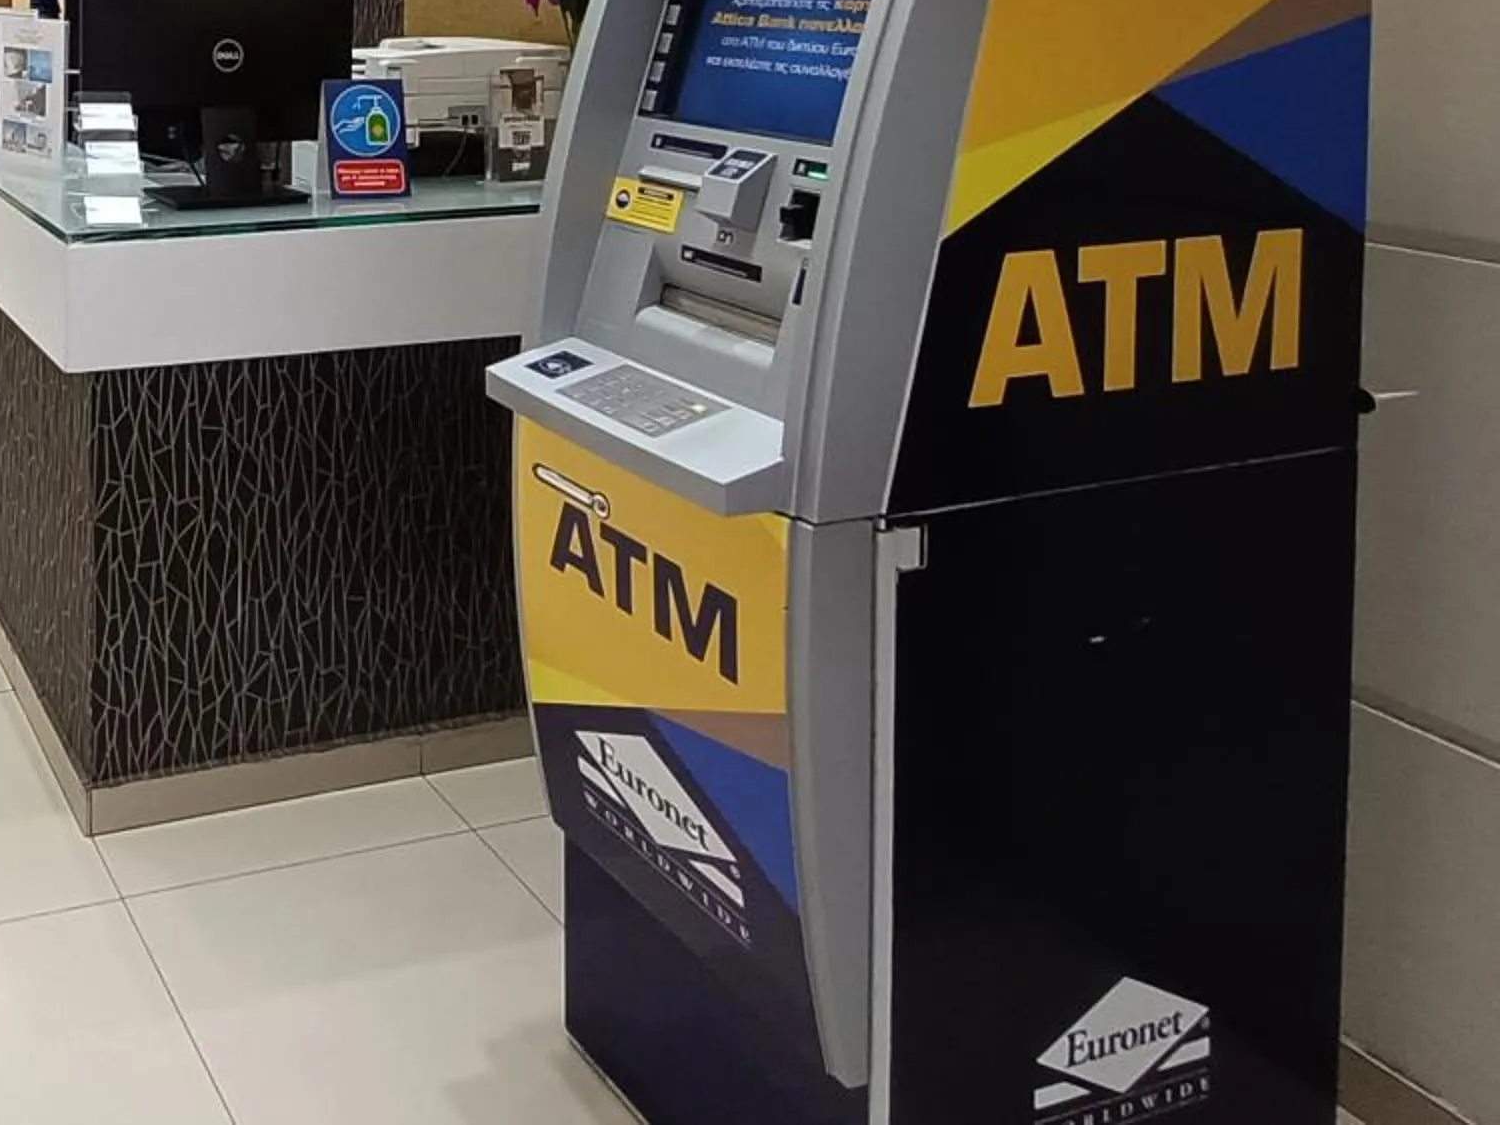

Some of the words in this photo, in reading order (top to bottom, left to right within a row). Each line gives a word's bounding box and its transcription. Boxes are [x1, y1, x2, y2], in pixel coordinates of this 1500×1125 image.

[711, 11, 754, 27] Attica
[967, 228, 1303, 408] ATM
[550, 502, 739, 686] ATM
[598, 736, 710, 852] Euronet
[583, 790, 751, 941] WORLDWIDE
[1066, 1011, 1183, 1069] Euronet
